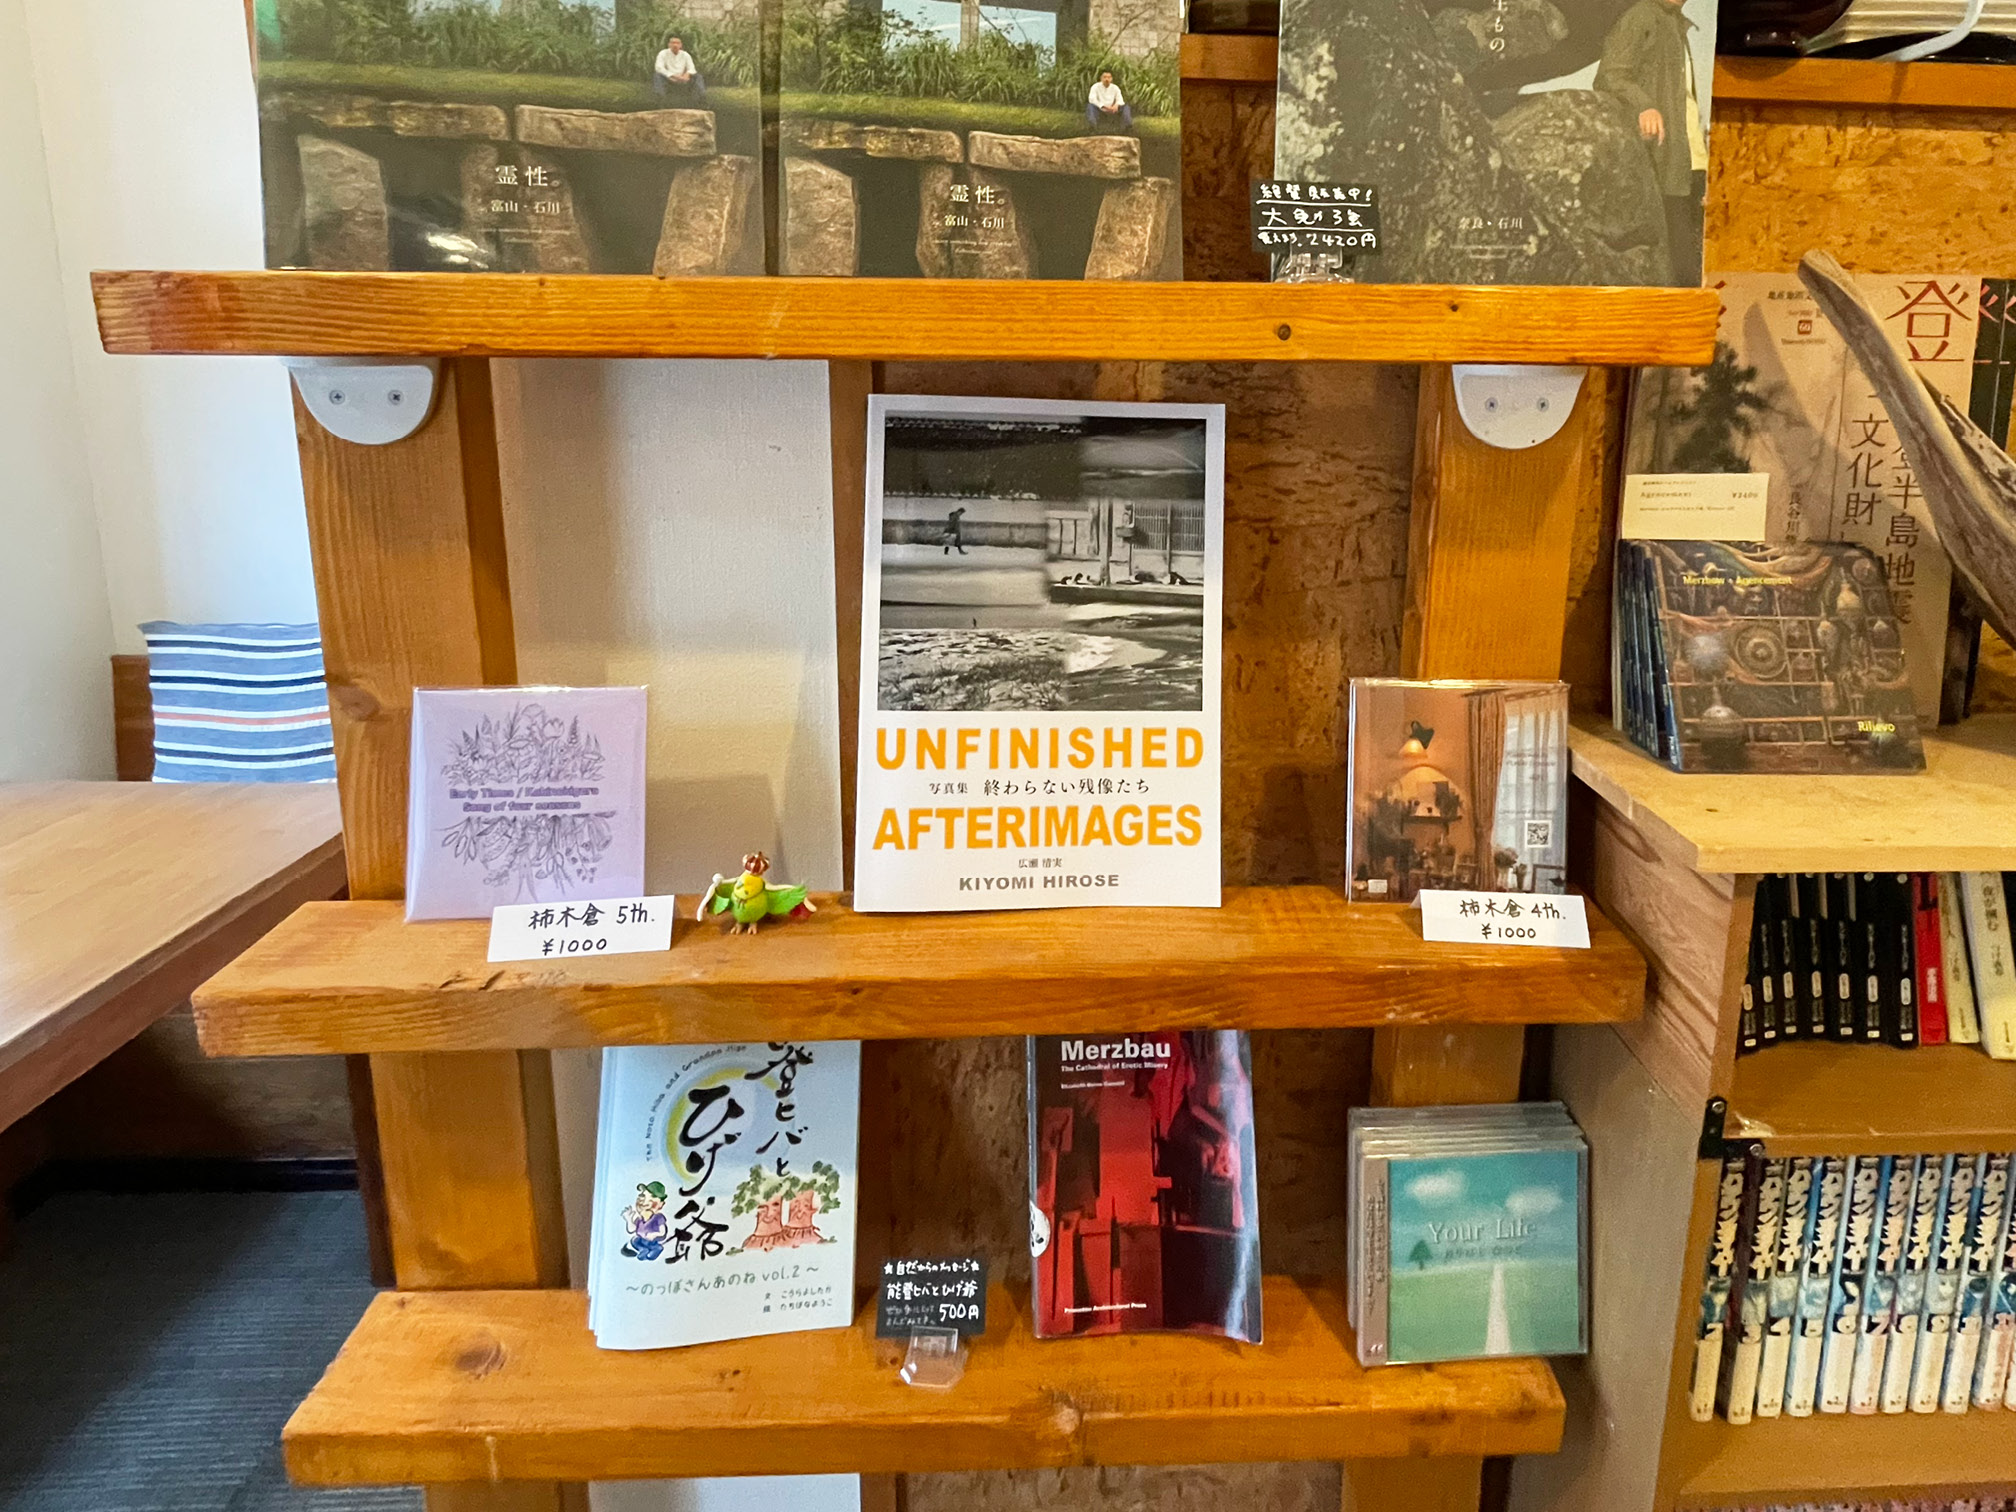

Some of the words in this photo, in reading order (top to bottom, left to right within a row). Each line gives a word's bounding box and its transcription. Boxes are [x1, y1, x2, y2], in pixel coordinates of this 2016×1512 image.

[876, 727, 1204, 770] UNFINISHED
[929, 781, 969, 795] 写真集
[983, 777, 1150, 797] 終わらない残像たち
[493, 801, 507, 811] of
[508, 801, 533, 811] four
[872, 804, 1202, 850] AFTERIMAGES
[959, 876, 1035, 892] KIYOMI
[1043, 873, 1120, 890] HIROSE
[528, 903, 605, 929] 柿木倉
[1460, 898, 1525, 918] 柿木倉
[1482, 923, 1537, 939] ¥1000
[542, 938, 607, 956] ¥1000
[1061, 1038, 1171, 1061] Merzbau
[1076, 1062, 1110, 1072] Cathedral
[1121, 1061, 1143, 1069] Erotic
[1429, 1222, 1484, 1244] Your
[1496, 1218, 1537, 1240] Life
[939, 1303, 979, 1322] 500円
